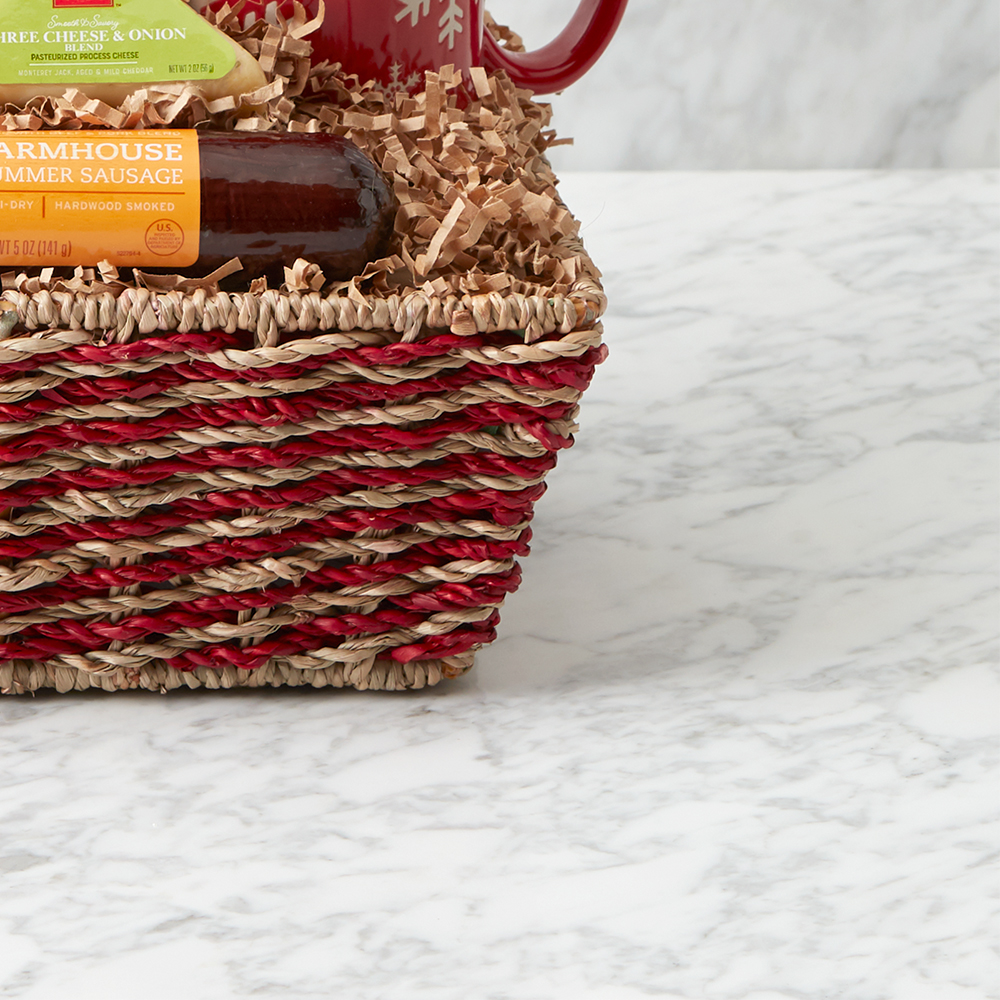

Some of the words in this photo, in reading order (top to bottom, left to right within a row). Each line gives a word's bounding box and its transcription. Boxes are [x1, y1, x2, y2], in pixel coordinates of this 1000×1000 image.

[43, 30, 109, 43] CHEESE
[113, 30, 125, 42] &
[128, 27, 187, 41] ONION
[64, 43, 103, 51] BLEND
[30, 53, 77, 61] PASTEURIZED
[79, 52, 111, 60] PROCESS
[112, 51, 139, 59] CHEESE
[103, 67, 120, 75] MILD
[122, 66, 153, 74] CHEDDAR
[168, 64, 178, 73] NET
[80, 167, 184, 184] SAUSAGE
[55, 201, 122, 211] HARDWOOD
[126, 202, 175, 212] SMOKED
[156, 223, 173, 232] U.S.
[13, 240, 19, 255] 5
[22, 240, 35, 256] OZ
[37, 240, 58, 257] (141
[61, 241, 72, 257] g)
